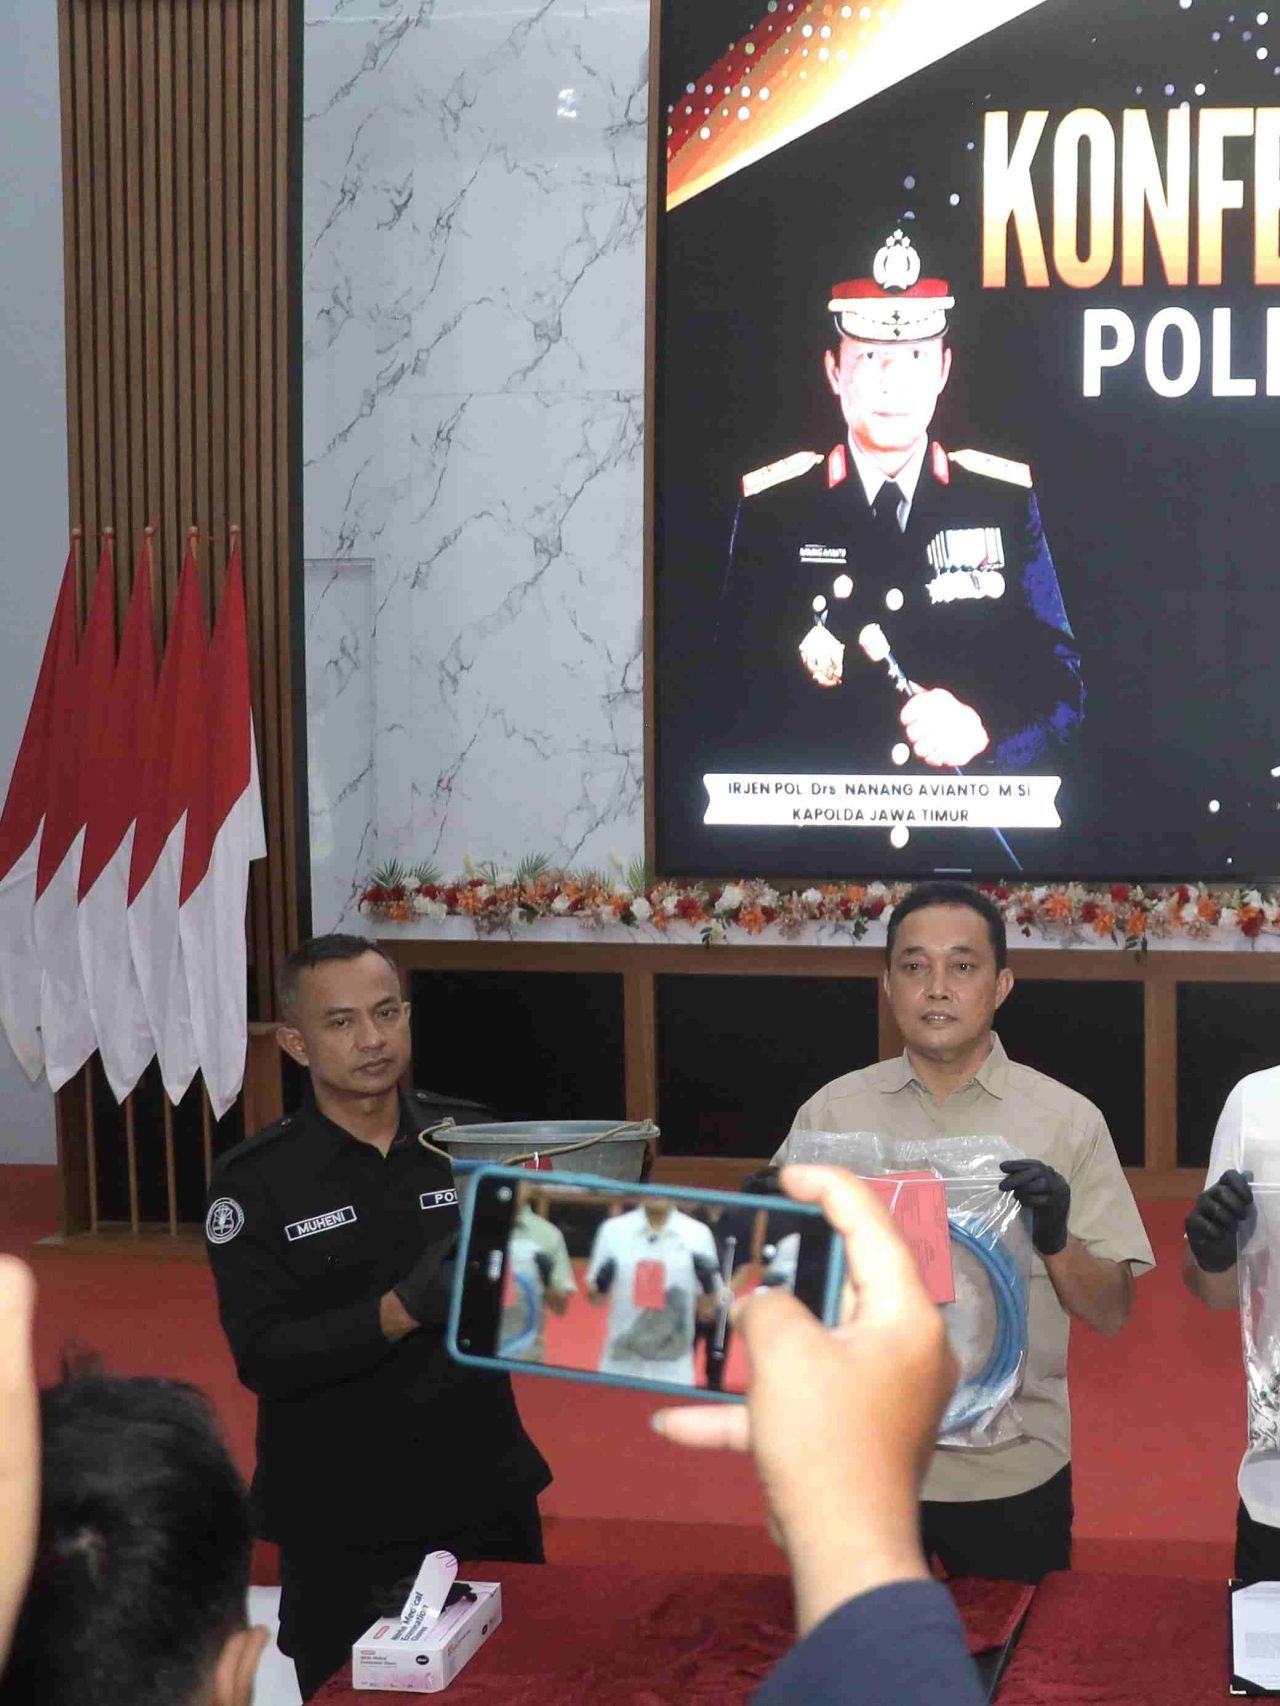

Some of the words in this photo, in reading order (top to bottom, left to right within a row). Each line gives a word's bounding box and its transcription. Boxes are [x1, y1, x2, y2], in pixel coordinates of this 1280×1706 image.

[728, 781, 771, 795] IRJEN
[845, 783, 913, 796] NANANG
[918, 784, 990, 797] AVIANTO
[792, 808, 865, 821] KAPOLDA
[870, 809, 916, 822] JAWA
[922, 809, 969, 822] TIMUR
[297, 1211, 346, 1235] MUHENI
